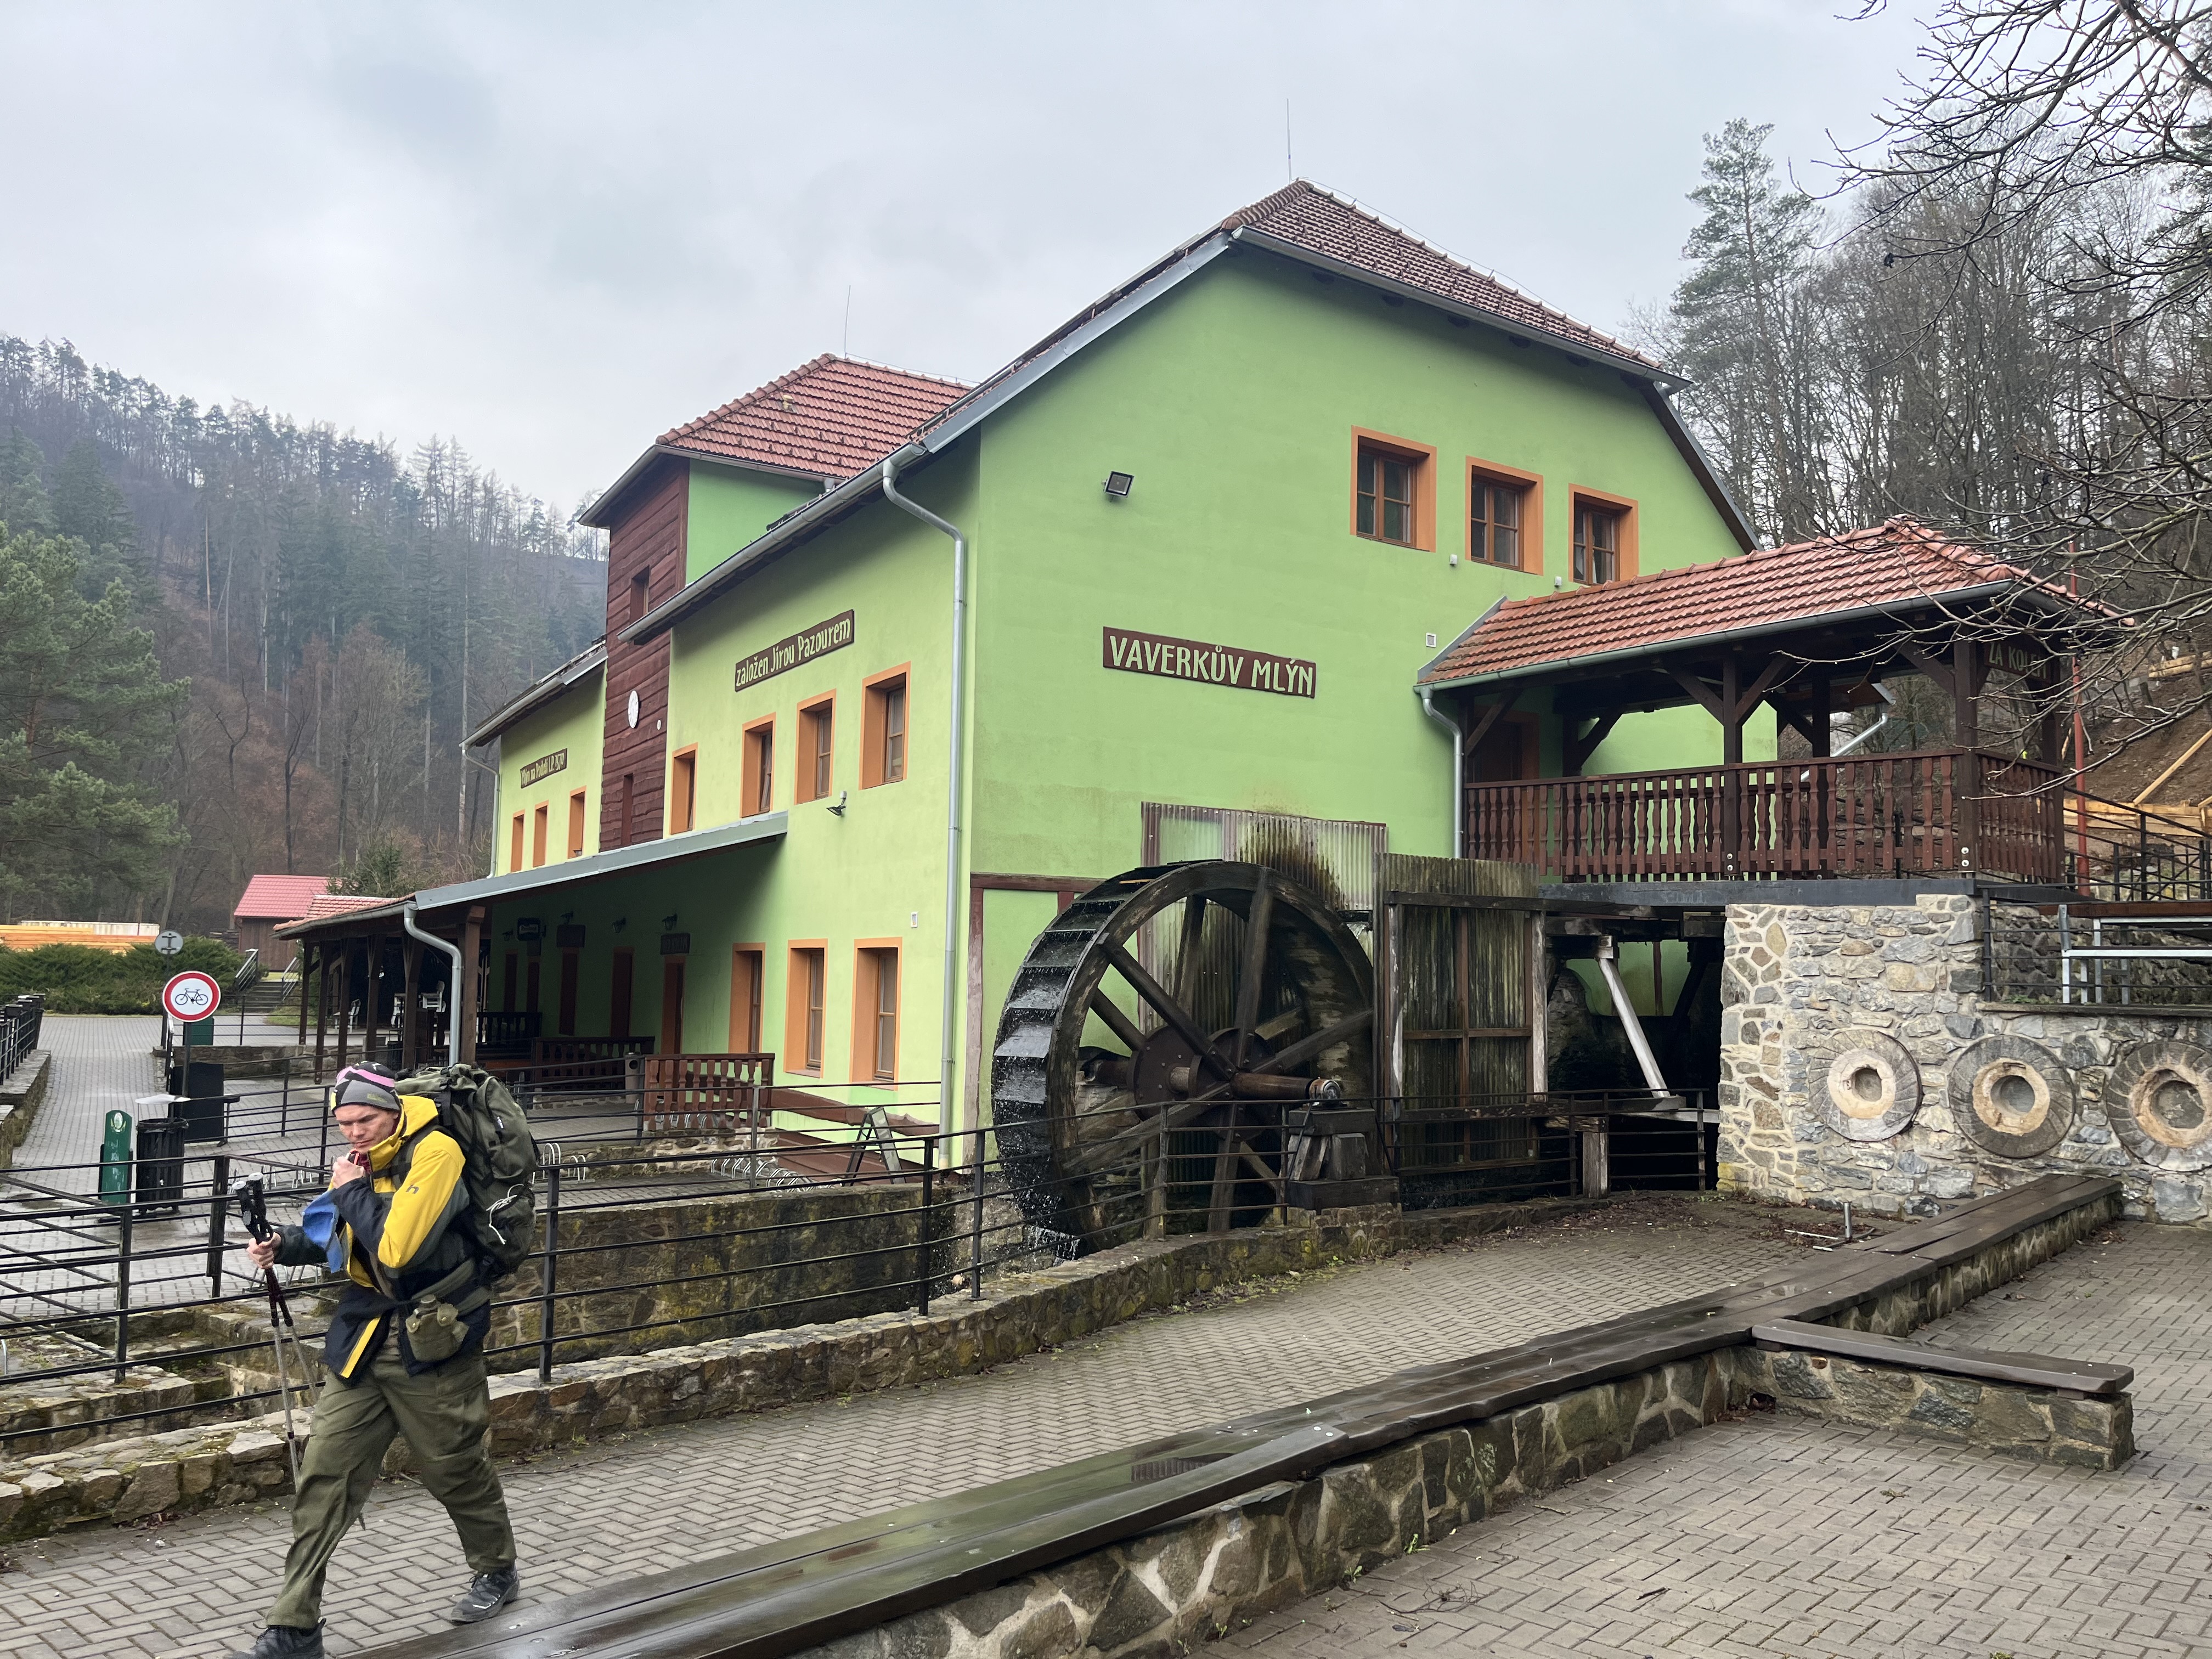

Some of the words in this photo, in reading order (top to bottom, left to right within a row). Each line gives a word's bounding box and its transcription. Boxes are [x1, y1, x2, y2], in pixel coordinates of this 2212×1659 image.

[736, 655, 769, 687] založen
[770, 644, 795, 673] Jírou
[797, 618, 851, 661] Pazourem
[1109, 635, 1244, 685] VAVERKŮV
[1250, 659, 1313, 696] MLÝN
